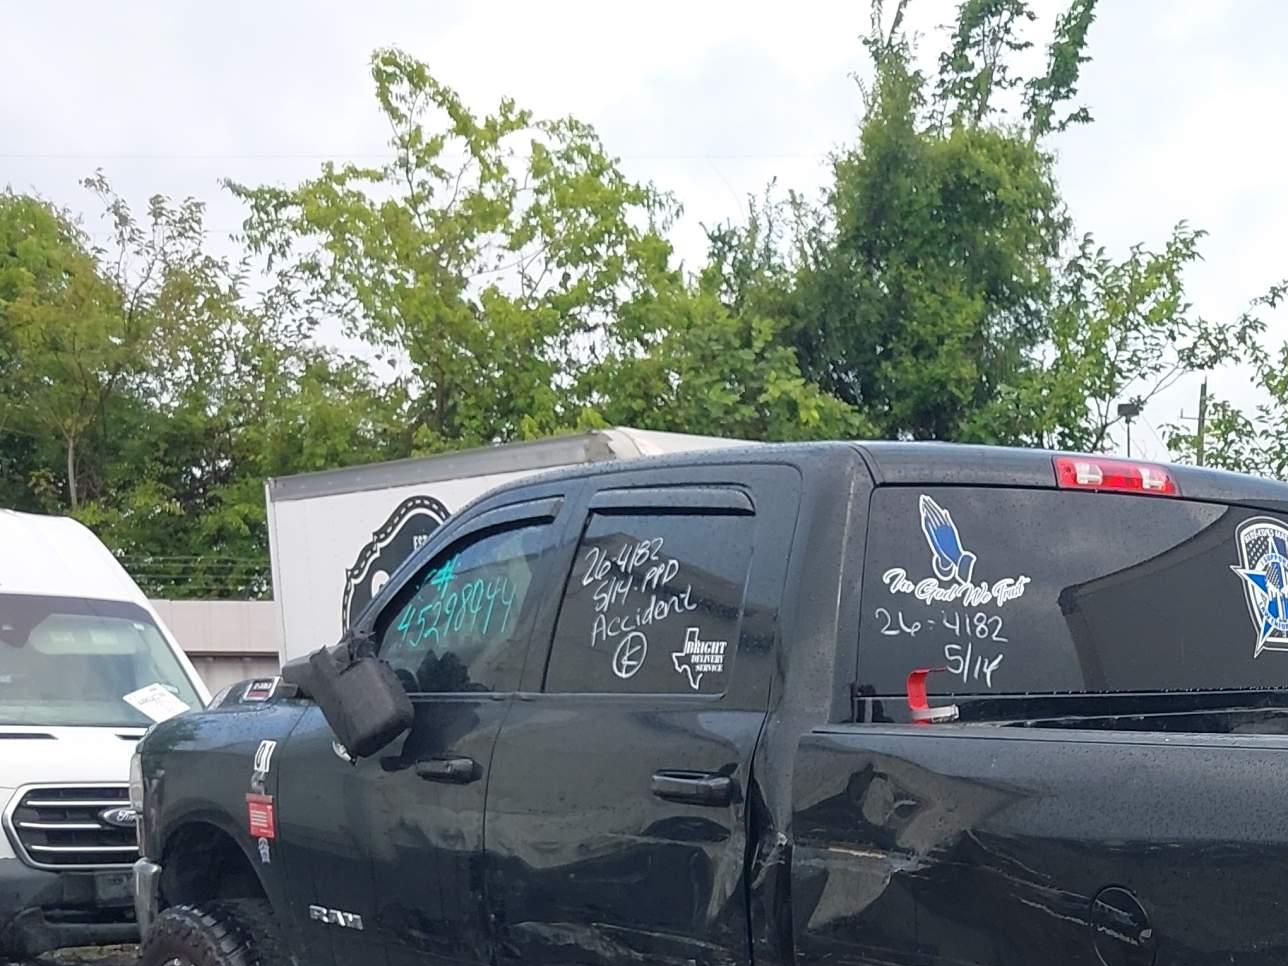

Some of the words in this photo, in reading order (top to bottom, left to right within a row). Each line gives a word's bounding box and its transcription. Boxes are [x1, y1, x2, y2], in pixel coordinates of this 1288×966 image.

[882, 568, 914, 594] In
[914, 578, 957, 605] God
[957, 582, 992, 607] We
[992, 576, 1031, 607] Trust
[591, 583, 698, 648] Accident
[686, 640, 728, 654] BRIGHT
[690, 654, 723, 664] DELIVERY
[695, 664, 723, 672] SERVICE
[943, 641, 1004, 689] 5/14
[309, 904, 363, 930] RAM
